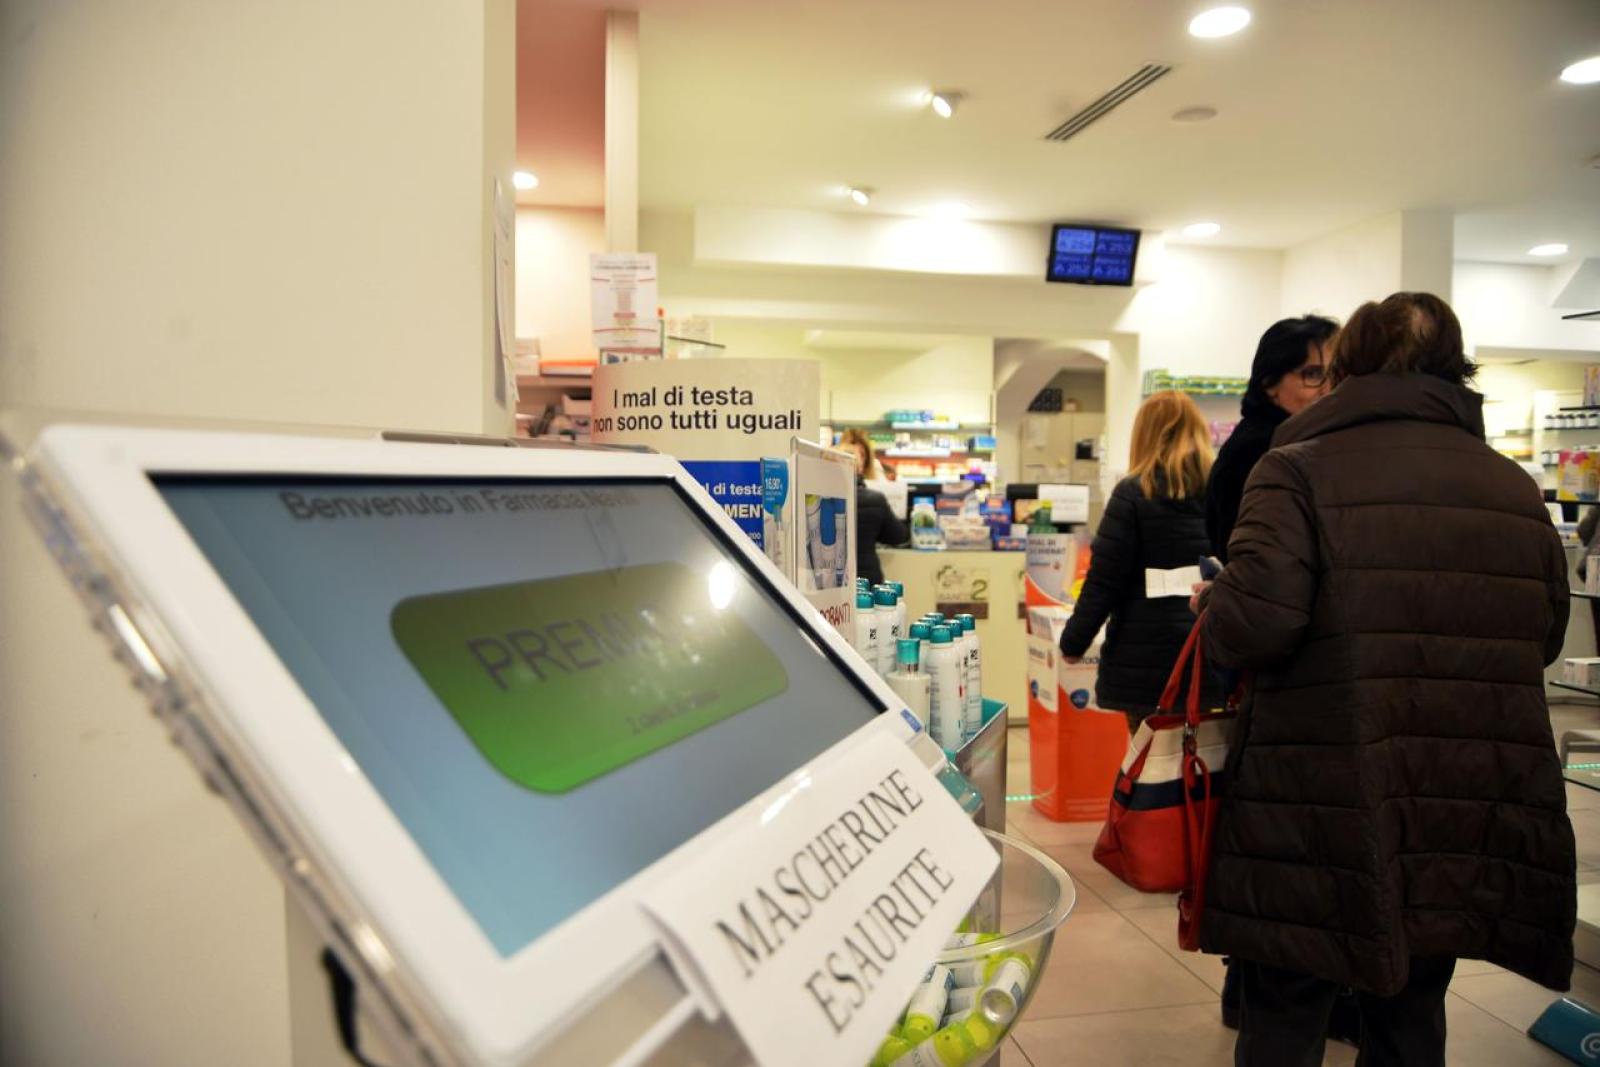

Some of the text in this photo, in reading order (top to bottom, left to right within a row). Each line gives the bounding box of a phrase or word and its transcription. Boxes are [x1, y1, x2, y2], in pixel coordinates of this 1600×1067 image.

[613, 386, 754, 409] I mal di testa
[593, 409, 801, 435] non sono tutti uguali
[713, 483, 726, 495] di
[279, 490, 454, 521] Benvenuto
[450, 490, 484, 513] in
[971, 579, 988, 601] 2
[715, 768, 923, 978] MASCHERINE
[805, 847, 955, 1037] ESAURITE
